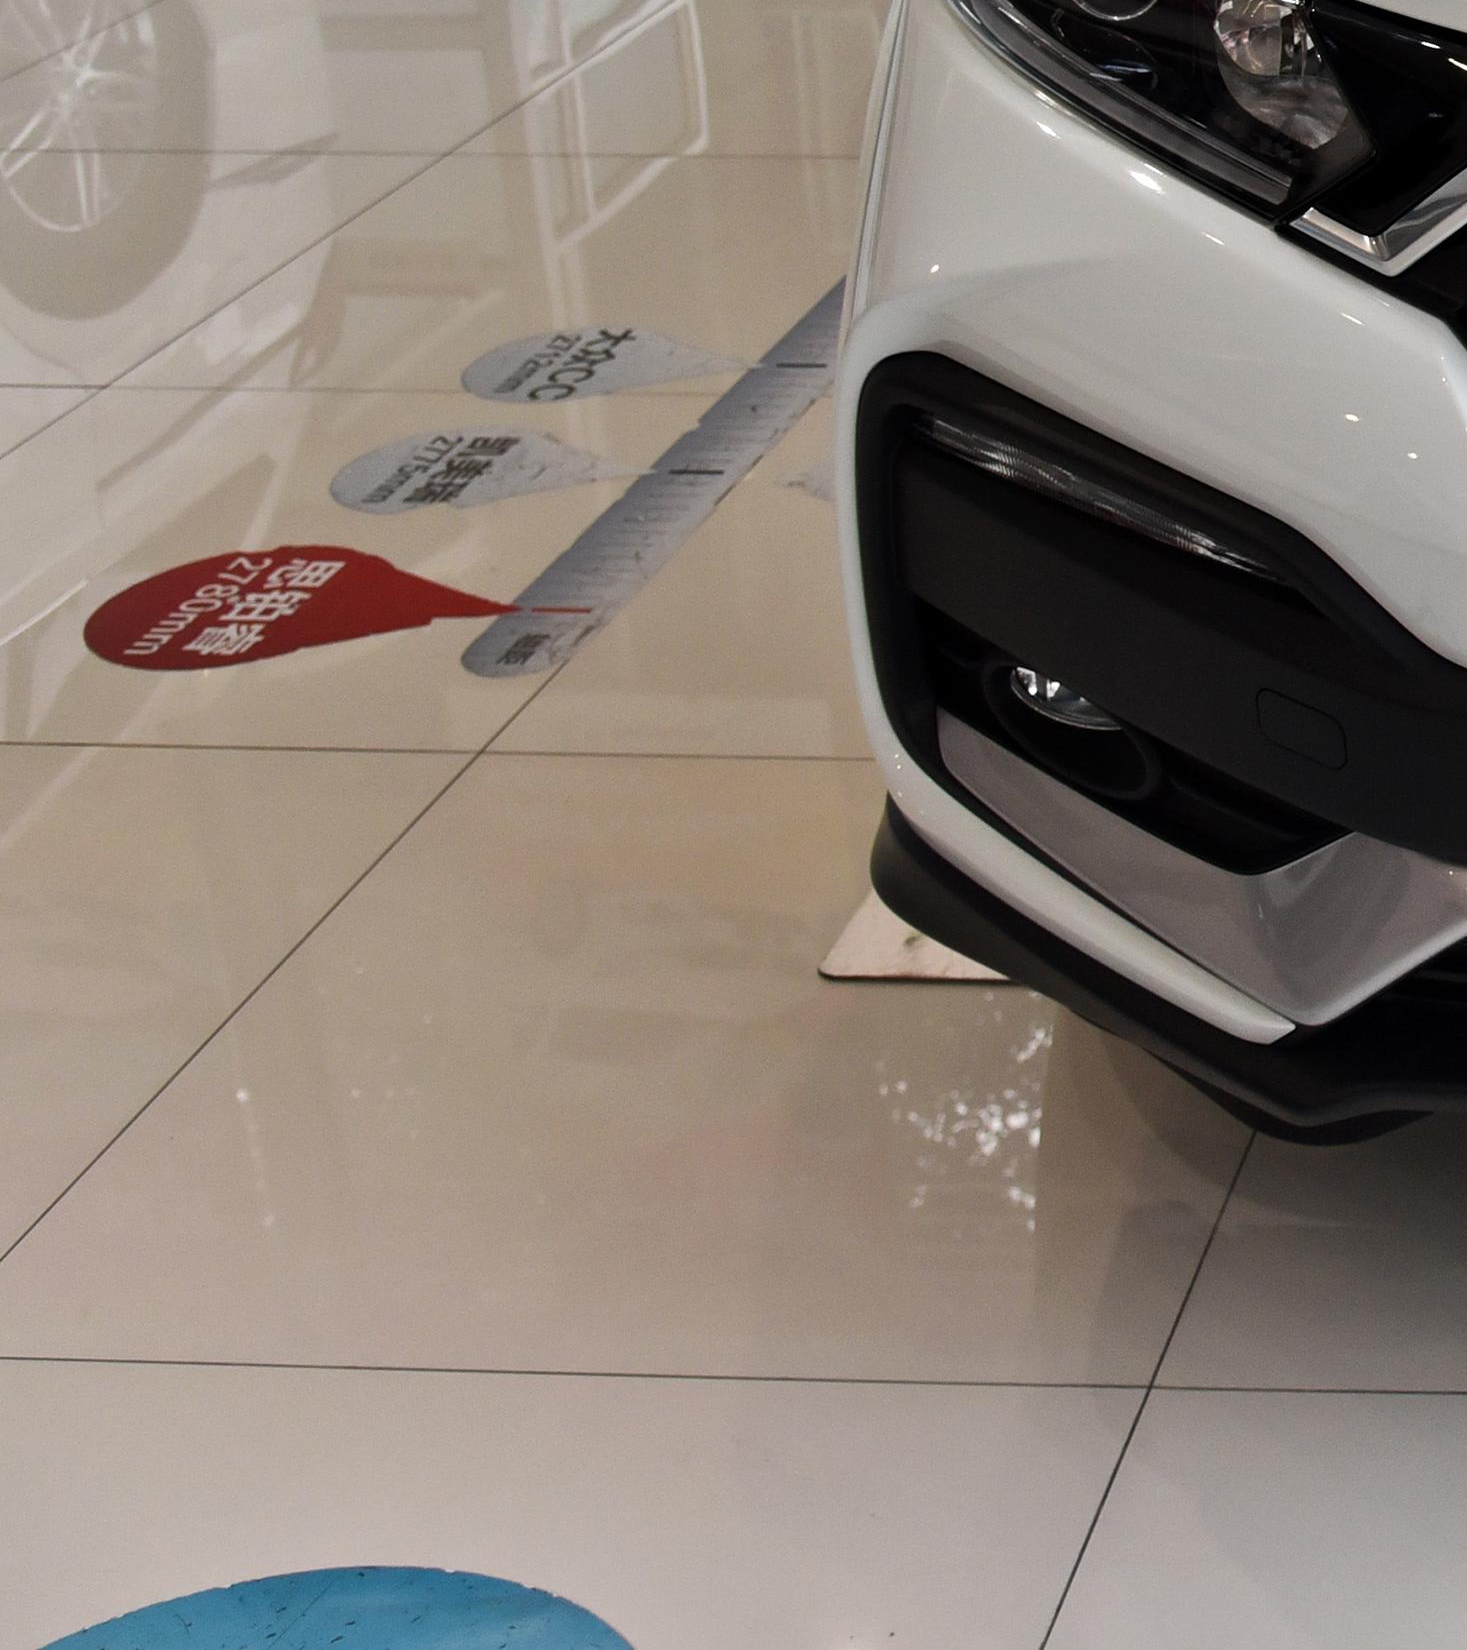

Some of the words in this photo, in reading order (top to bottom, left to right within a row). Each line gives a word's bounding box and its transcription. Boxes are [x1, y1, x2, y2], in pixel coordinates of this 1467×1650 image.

[527, 327, 637, 401] 大众CC
[403, 436, 523, 503] 凯美瑞
[123, 556, 274, 656] 2780mm
[182, 558, 347, 657] 思铂睿
